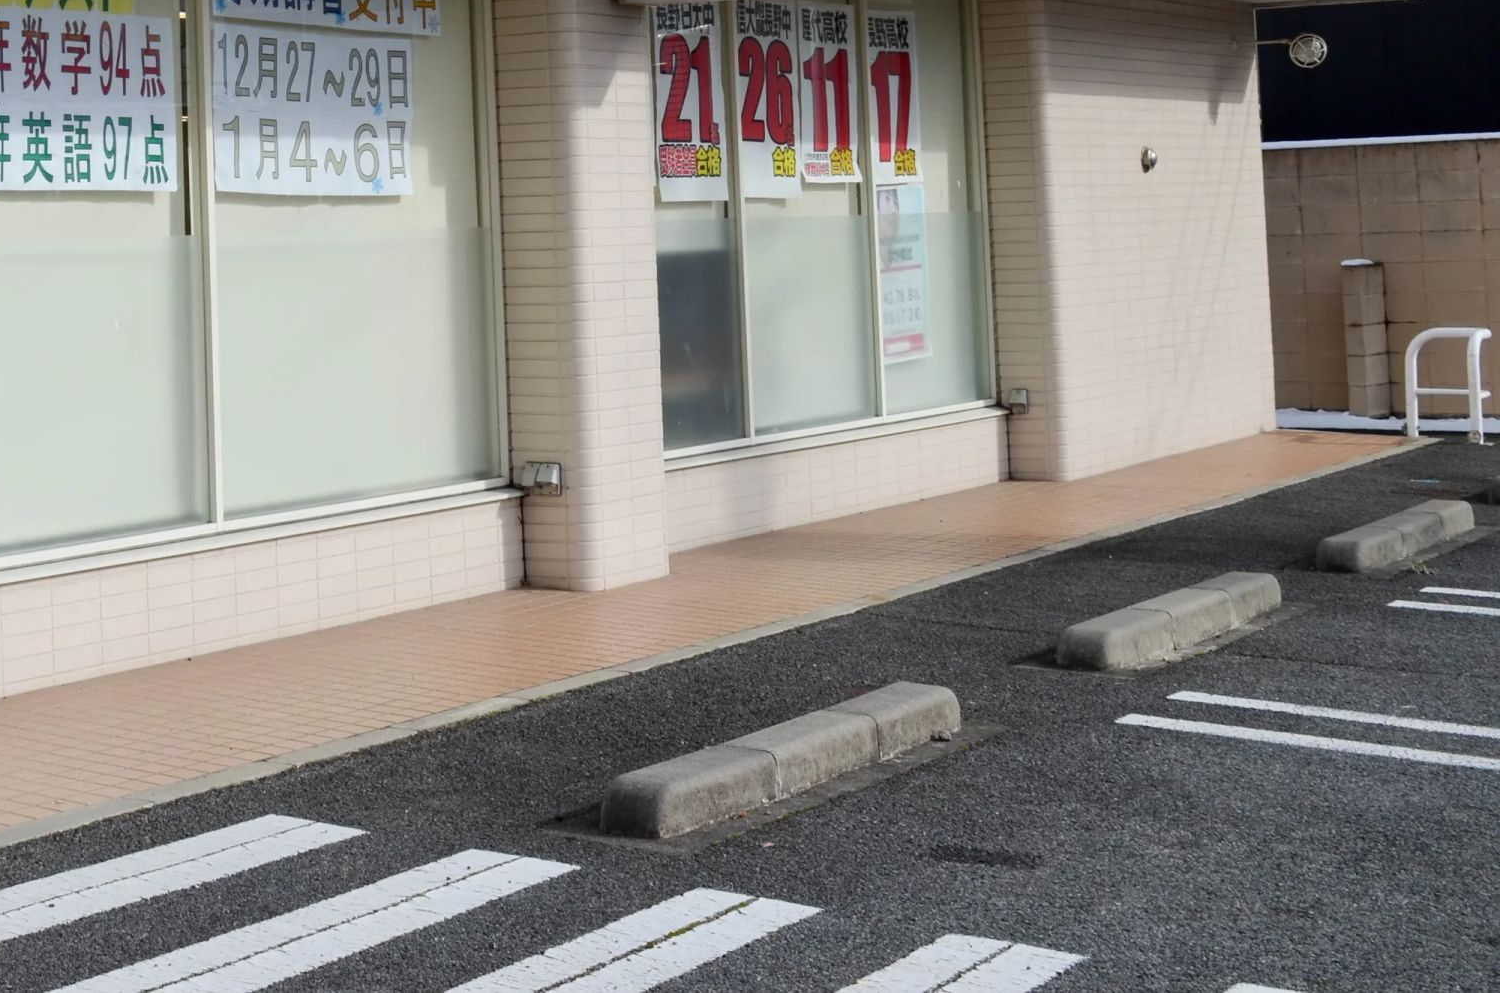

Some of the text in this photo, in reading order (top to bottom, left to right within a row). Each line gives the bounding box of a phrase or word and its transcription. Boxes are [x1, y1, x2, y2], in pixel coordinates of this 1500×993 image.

[696, 145, 721, 177] 合格
[772, 146, 796, 177] 合格
[829, 147, 855, 175] 合格
[893, 148, 917, 176] 合格
